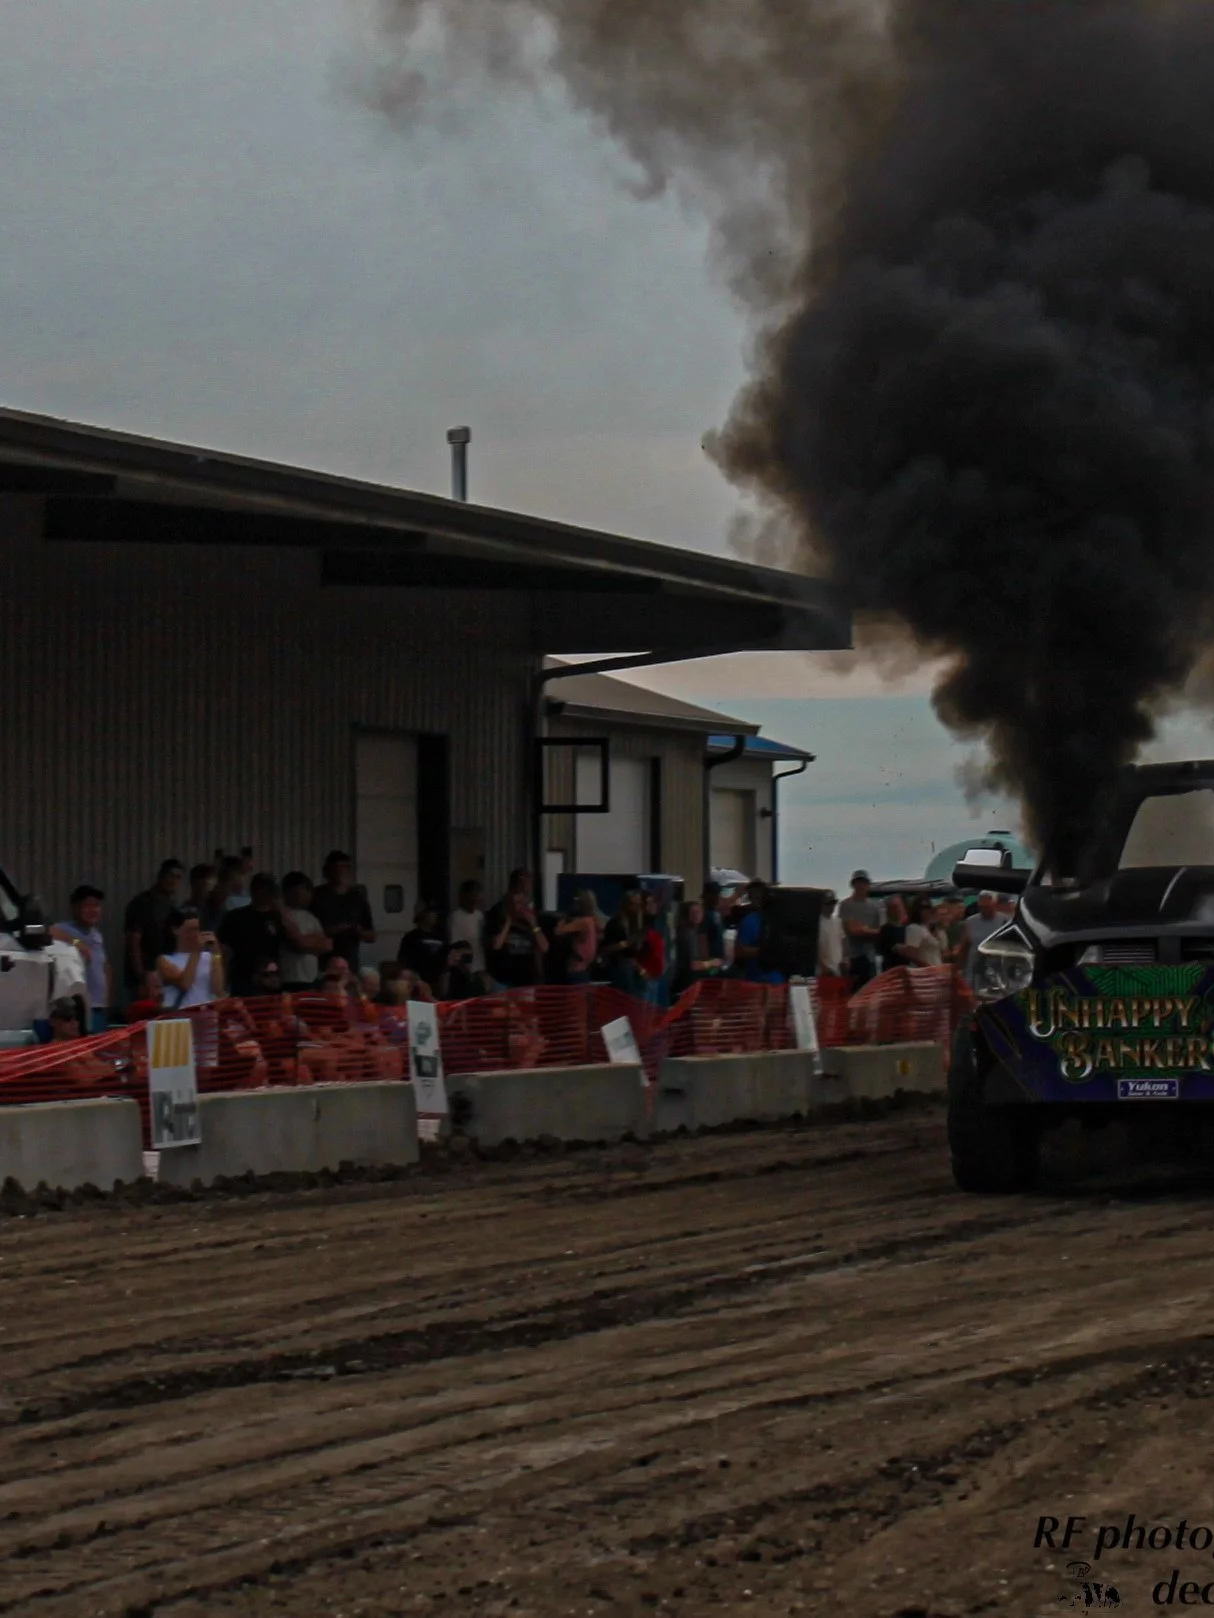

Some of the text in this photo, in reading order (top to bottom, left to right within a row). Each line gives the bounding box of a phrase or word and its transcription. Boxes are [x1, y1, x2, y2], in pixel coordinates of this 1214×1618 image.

[1026, 987, 1196, 1038] UNHAPPY
[1059, 1031, 1212, 1078] BANKER
[1128, 1081, 1169, 1091] Yukon
